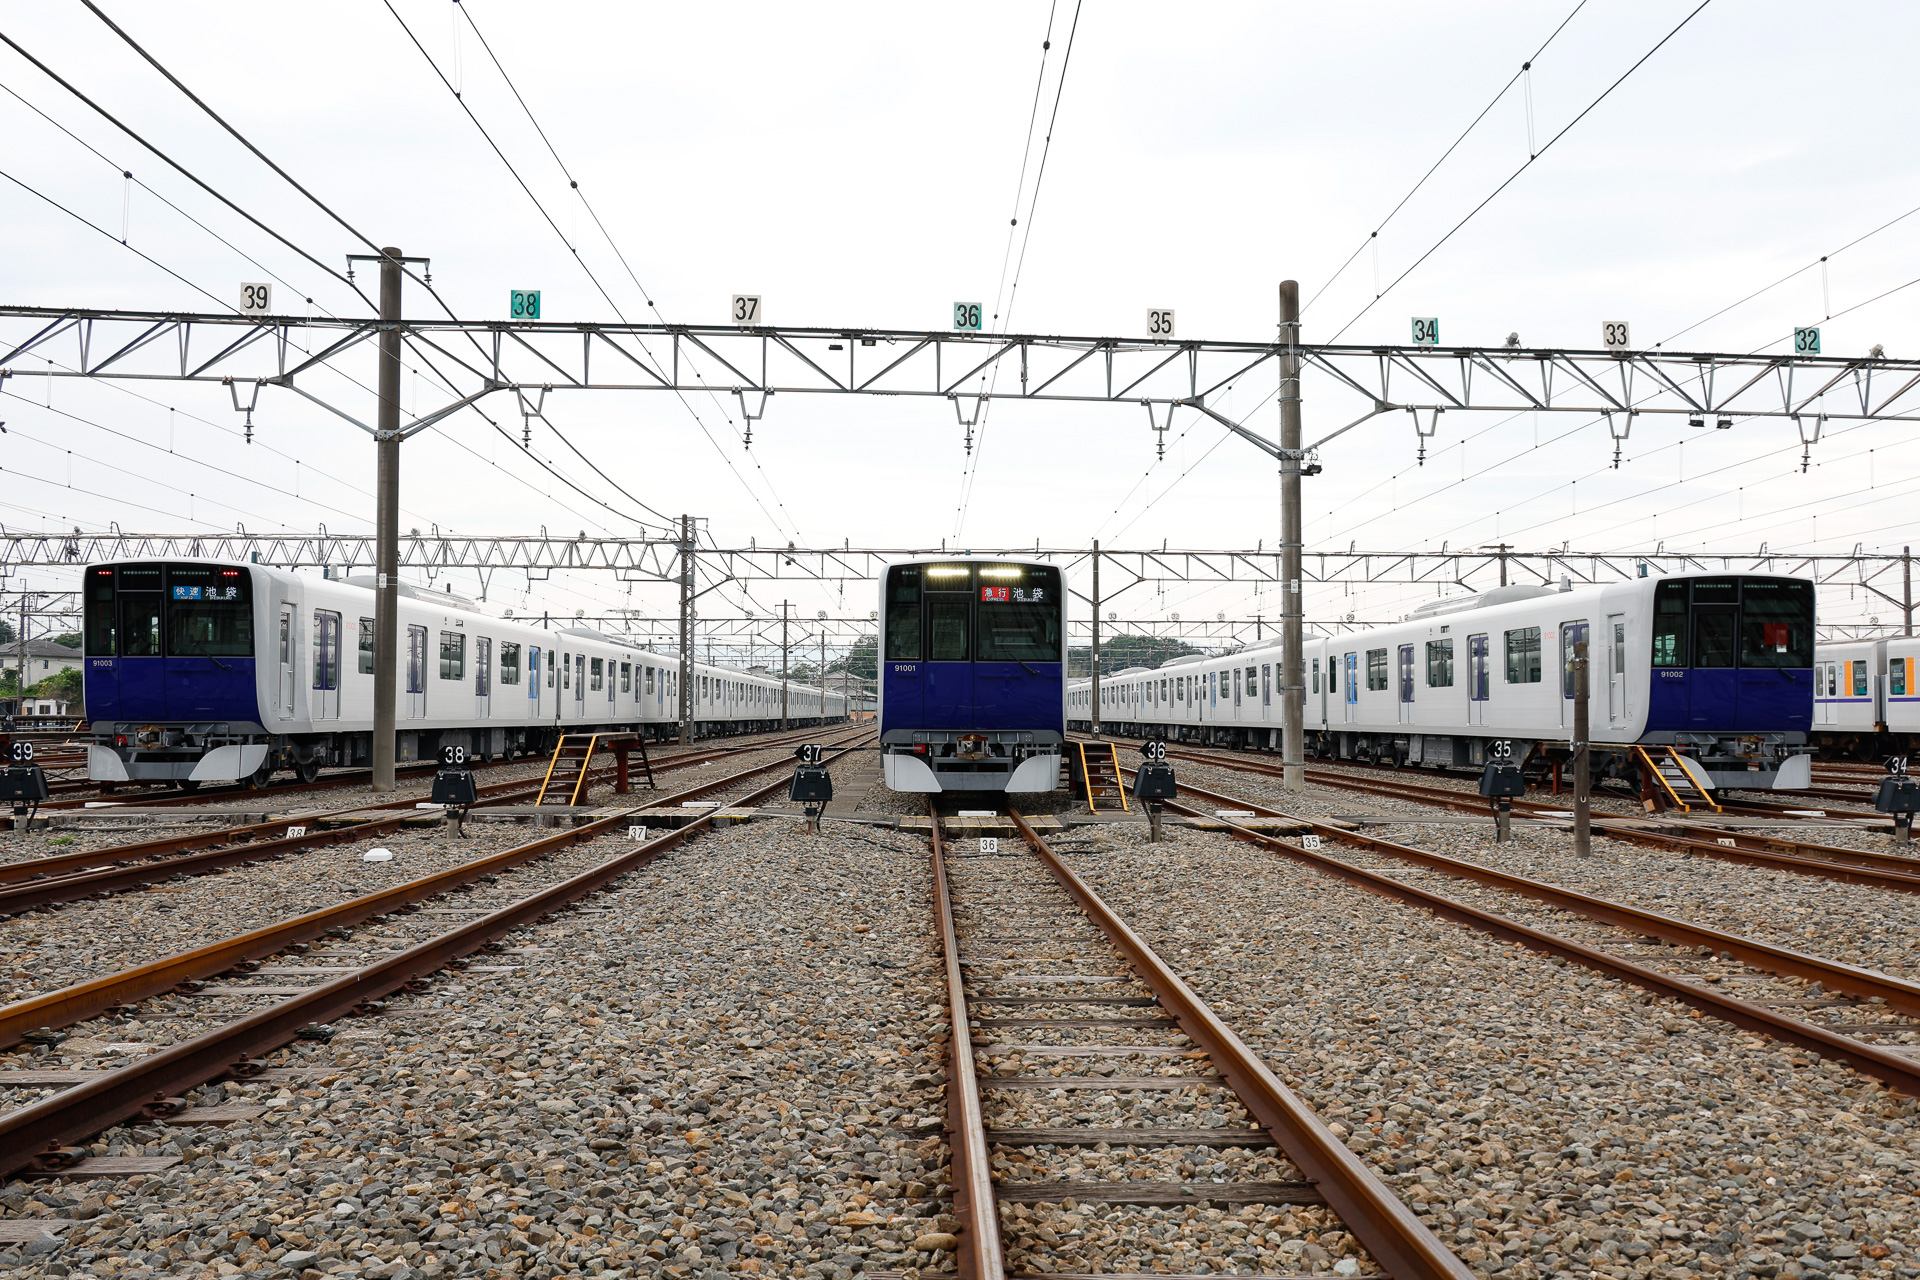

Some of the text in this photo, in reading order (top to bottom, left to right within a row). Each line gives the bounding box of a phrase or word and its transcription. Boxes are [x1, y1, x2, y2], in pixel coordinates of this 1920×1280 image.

[245, 286, 268, 310] 39
[514, 292, 537, 316] 38
[735, 297, 758, 319] 37
[956, 304, 979, 327] 36
[1150, 312, 1172, 334] 35
[1415, 320, 1437, 342] 34
[1605, 324, 1628, 346] 33
[1797, 330, 1819, 351] 32
[175, 586, 237, 597] 快速 池袋
[984, 587, 1044, 599] 急行 池袋
[894, 664, 916, 672] 91001
[13, 742, 33, 761] 39
[445, 746, 464, 764] 38
[803, 744, 821, 762] 37
[1147, 741, 1166, 759] 36
[1494, 740, 1511, 758] 35
[1891, 756, 1908, 774] 34
[288, 828, 303, 838] 38
[629, 827, 644, 839] 37
[982, 839, 995, 850] 36
[1305, 837, 1318, 848] 35
